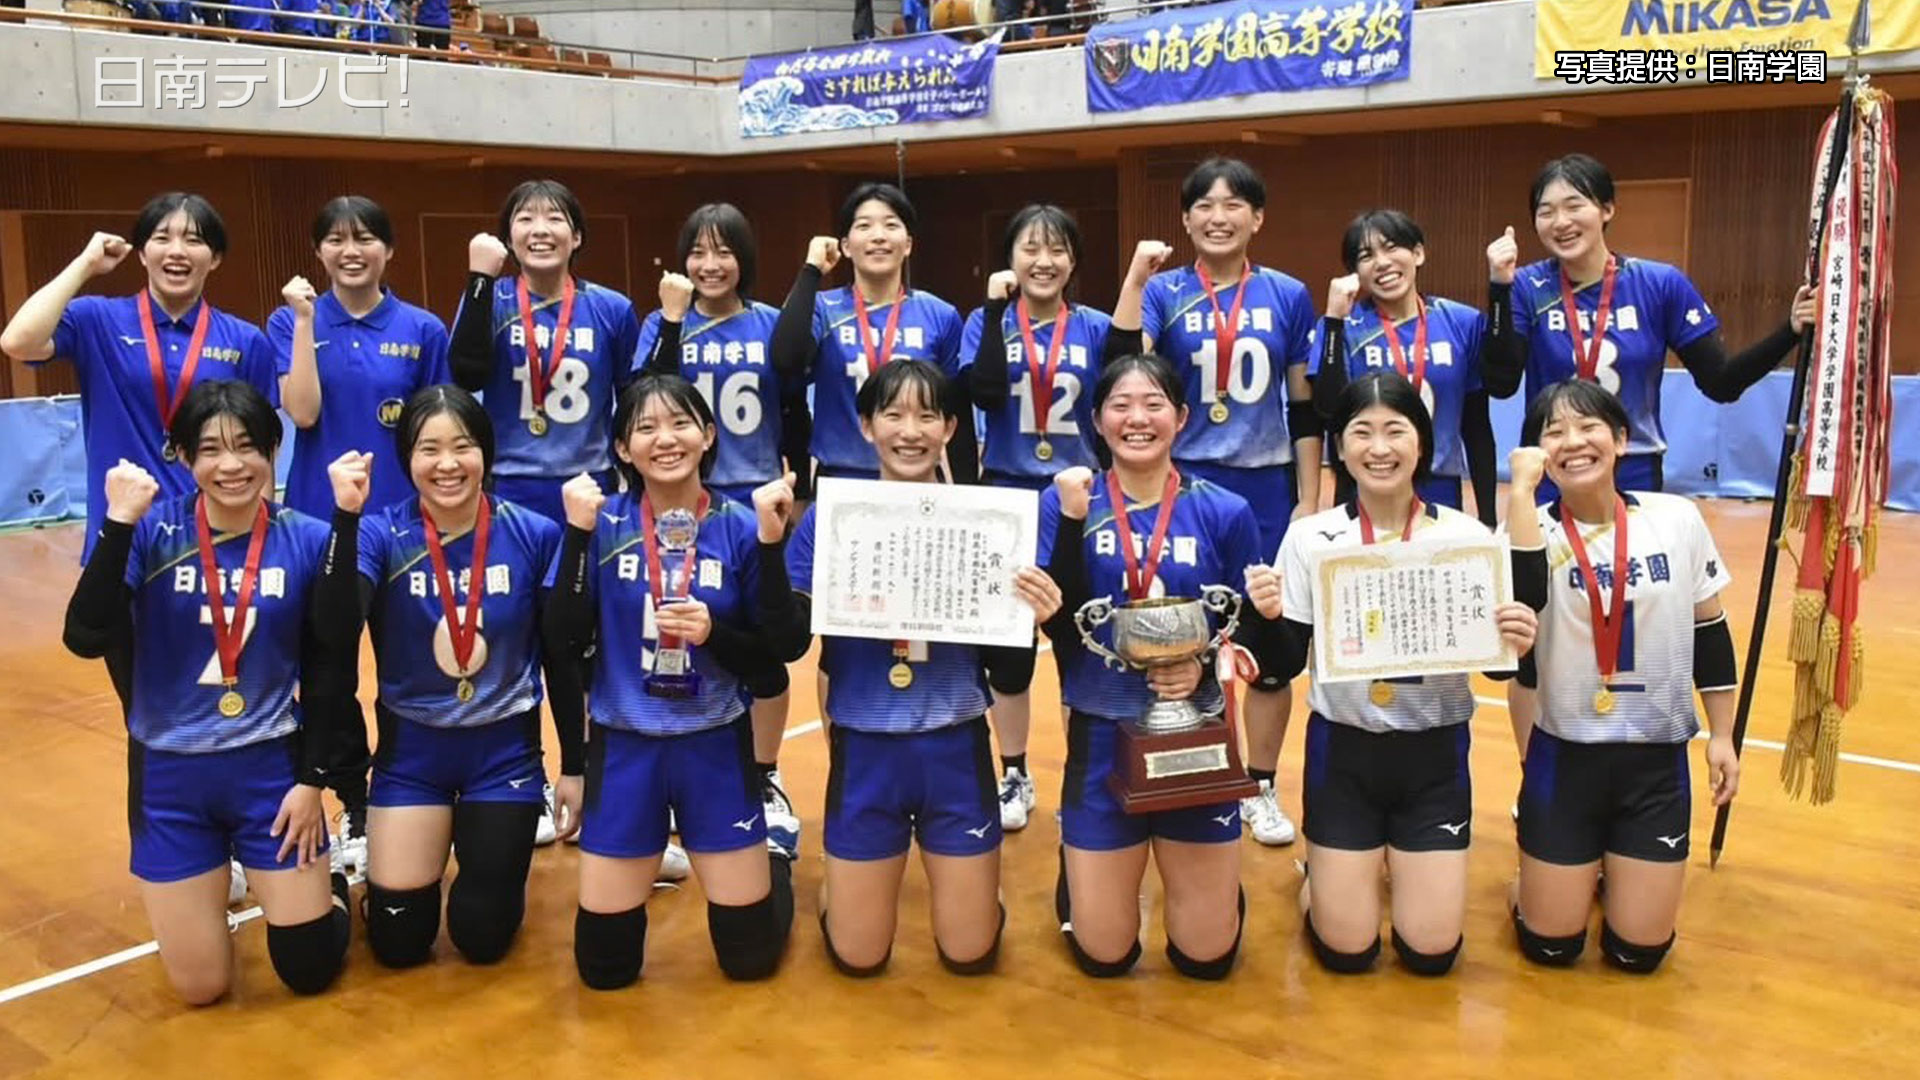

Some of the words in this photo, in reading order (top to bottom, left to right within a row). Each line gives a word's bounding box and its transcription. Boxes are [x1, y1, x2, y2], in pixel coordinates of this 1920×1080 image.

[1131, 1, 1404, 72] 日南学園高等学校
[682, 341, 765, 365] 日南学園
[1191, 337, 1272, 404] 10
[1815, 255, 1845, 471] 宮崎日本大学学園高等学校
[512, 356, 590, 424] 18
[1010, 372, 1082, 435] 12
[986, 552, 1004, 599] 賞状
[1469, 584, 1486, 620] 賞状
[197, 605, 258, 685] 7
